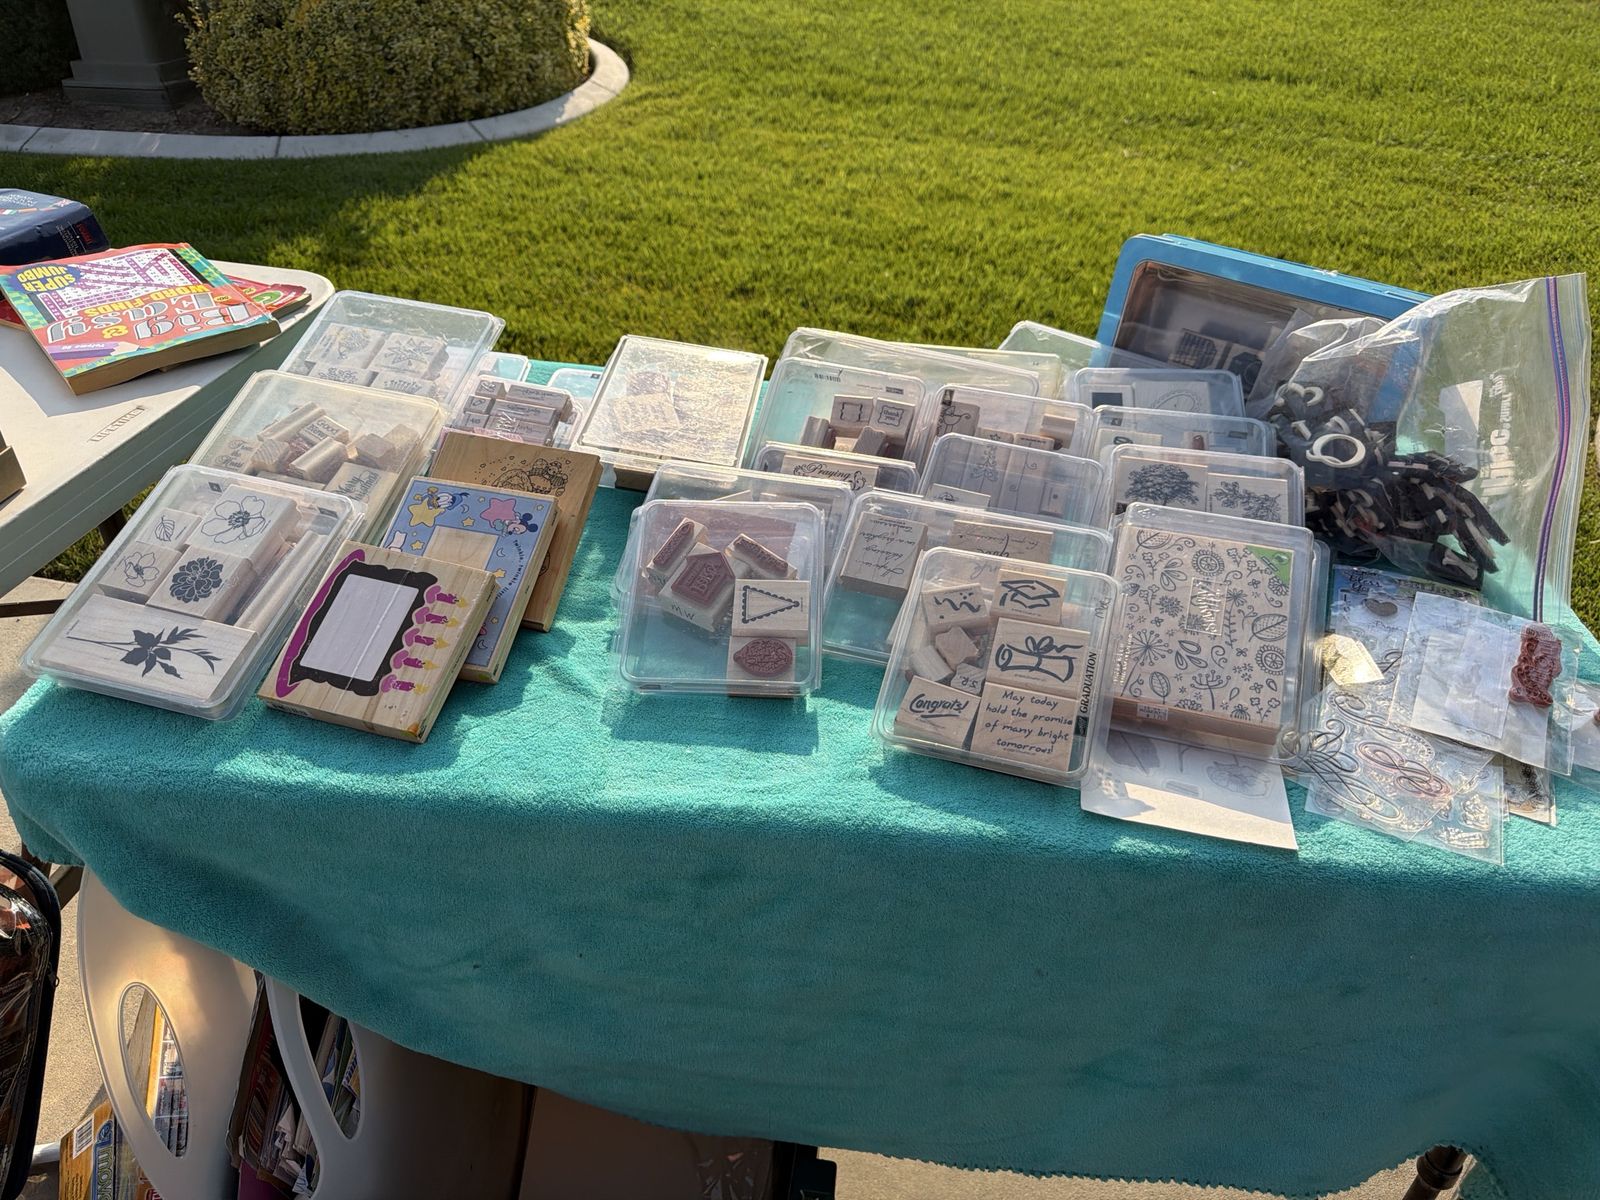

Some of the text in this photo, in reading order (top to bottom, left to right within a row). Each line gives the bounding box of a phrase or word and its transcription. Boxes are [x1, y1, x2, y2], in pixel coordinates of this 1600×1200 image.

[18, 266, 67, 283] JUMBO
[22, 274, 75, 293] SUPER
[84, 285, 209, 317] WORD-FINDS
[47, 292, 214, 343] Easy
[133, 303, 250, 340] Big
[101, 325, 129, 339] &
[316, 419, 341, 435] Good
[806, 462, 851, 480] Praying
[1079, 651, 1097, 714] GRADUATION
[909, 693, 970, 714] Congrats!
[1002, 691, 1060, 711] May today
[986, 703, 1073, 726] hold the promise
[985, 719, 1070, 744] of many bright
[996, 738, 1054, 753] tomorrows!
